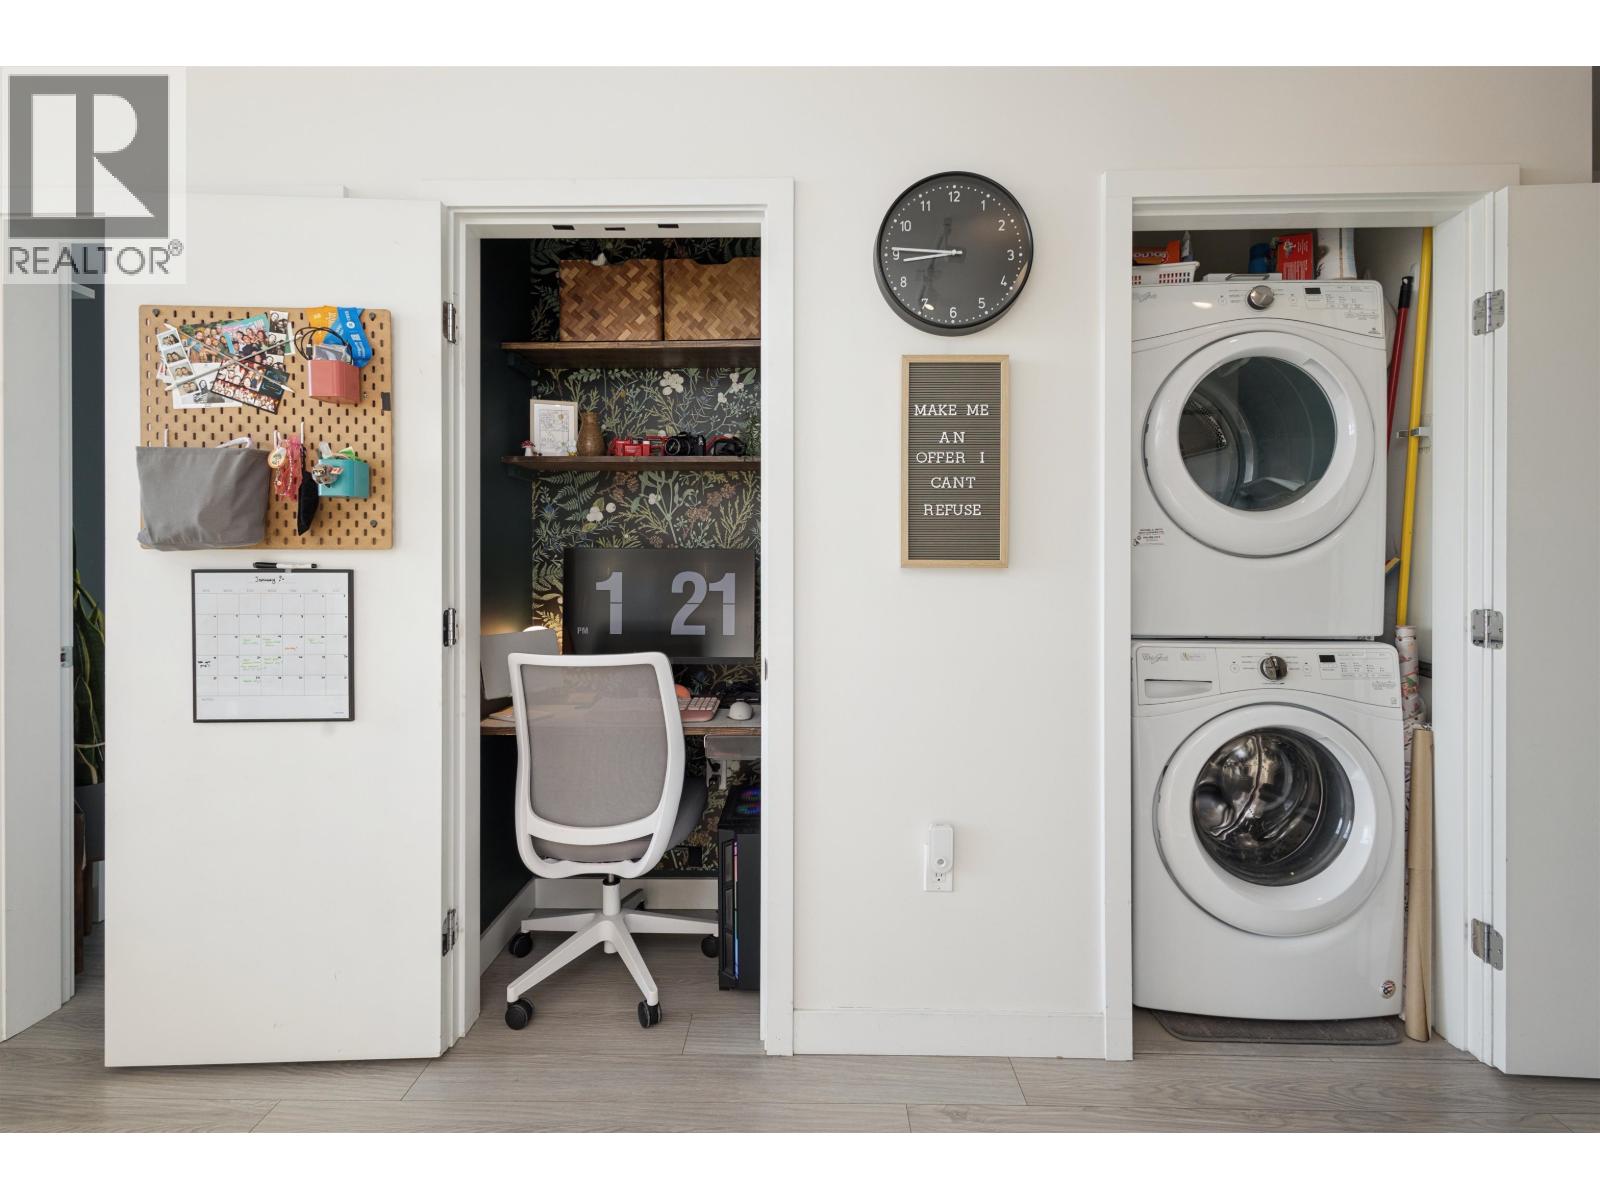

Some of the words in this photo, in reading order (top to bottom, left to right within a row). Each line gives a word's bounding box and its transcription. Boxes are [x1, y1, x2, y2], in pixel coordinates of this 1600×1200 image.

[948, 191, 961, 203] 12
[920, 200, 931, 212] 11
[980, 200, 986, 211] 1
[899, 220, 912, 232] 10
[998, 219, 1005, 231] 2
[892, 249, 900, 261] 9
[1007, 250, 1015, 261] 3
[900, 276, 907, 288] 8
[1000, 275, 1008, 286] 4
[921, 298, 929, 310] 7
[978, 297, 986, 309] 5
[950, 307, 957, 318] 6
[914, 404, 957, 416] MAKE
[966, 404, 989, 416] ME
[938, 431, 966, 444] AN
[916, 451, 966, 464] OFFER
[979, 451, 985, 464] I
[930, 476, 976, 489] CANT
[923, 503, 982, 516] REFUSE
[596, 571, 623, 635] 1
[671, 571, 736, 636] 21
[577, 626, 589, 635] PM
